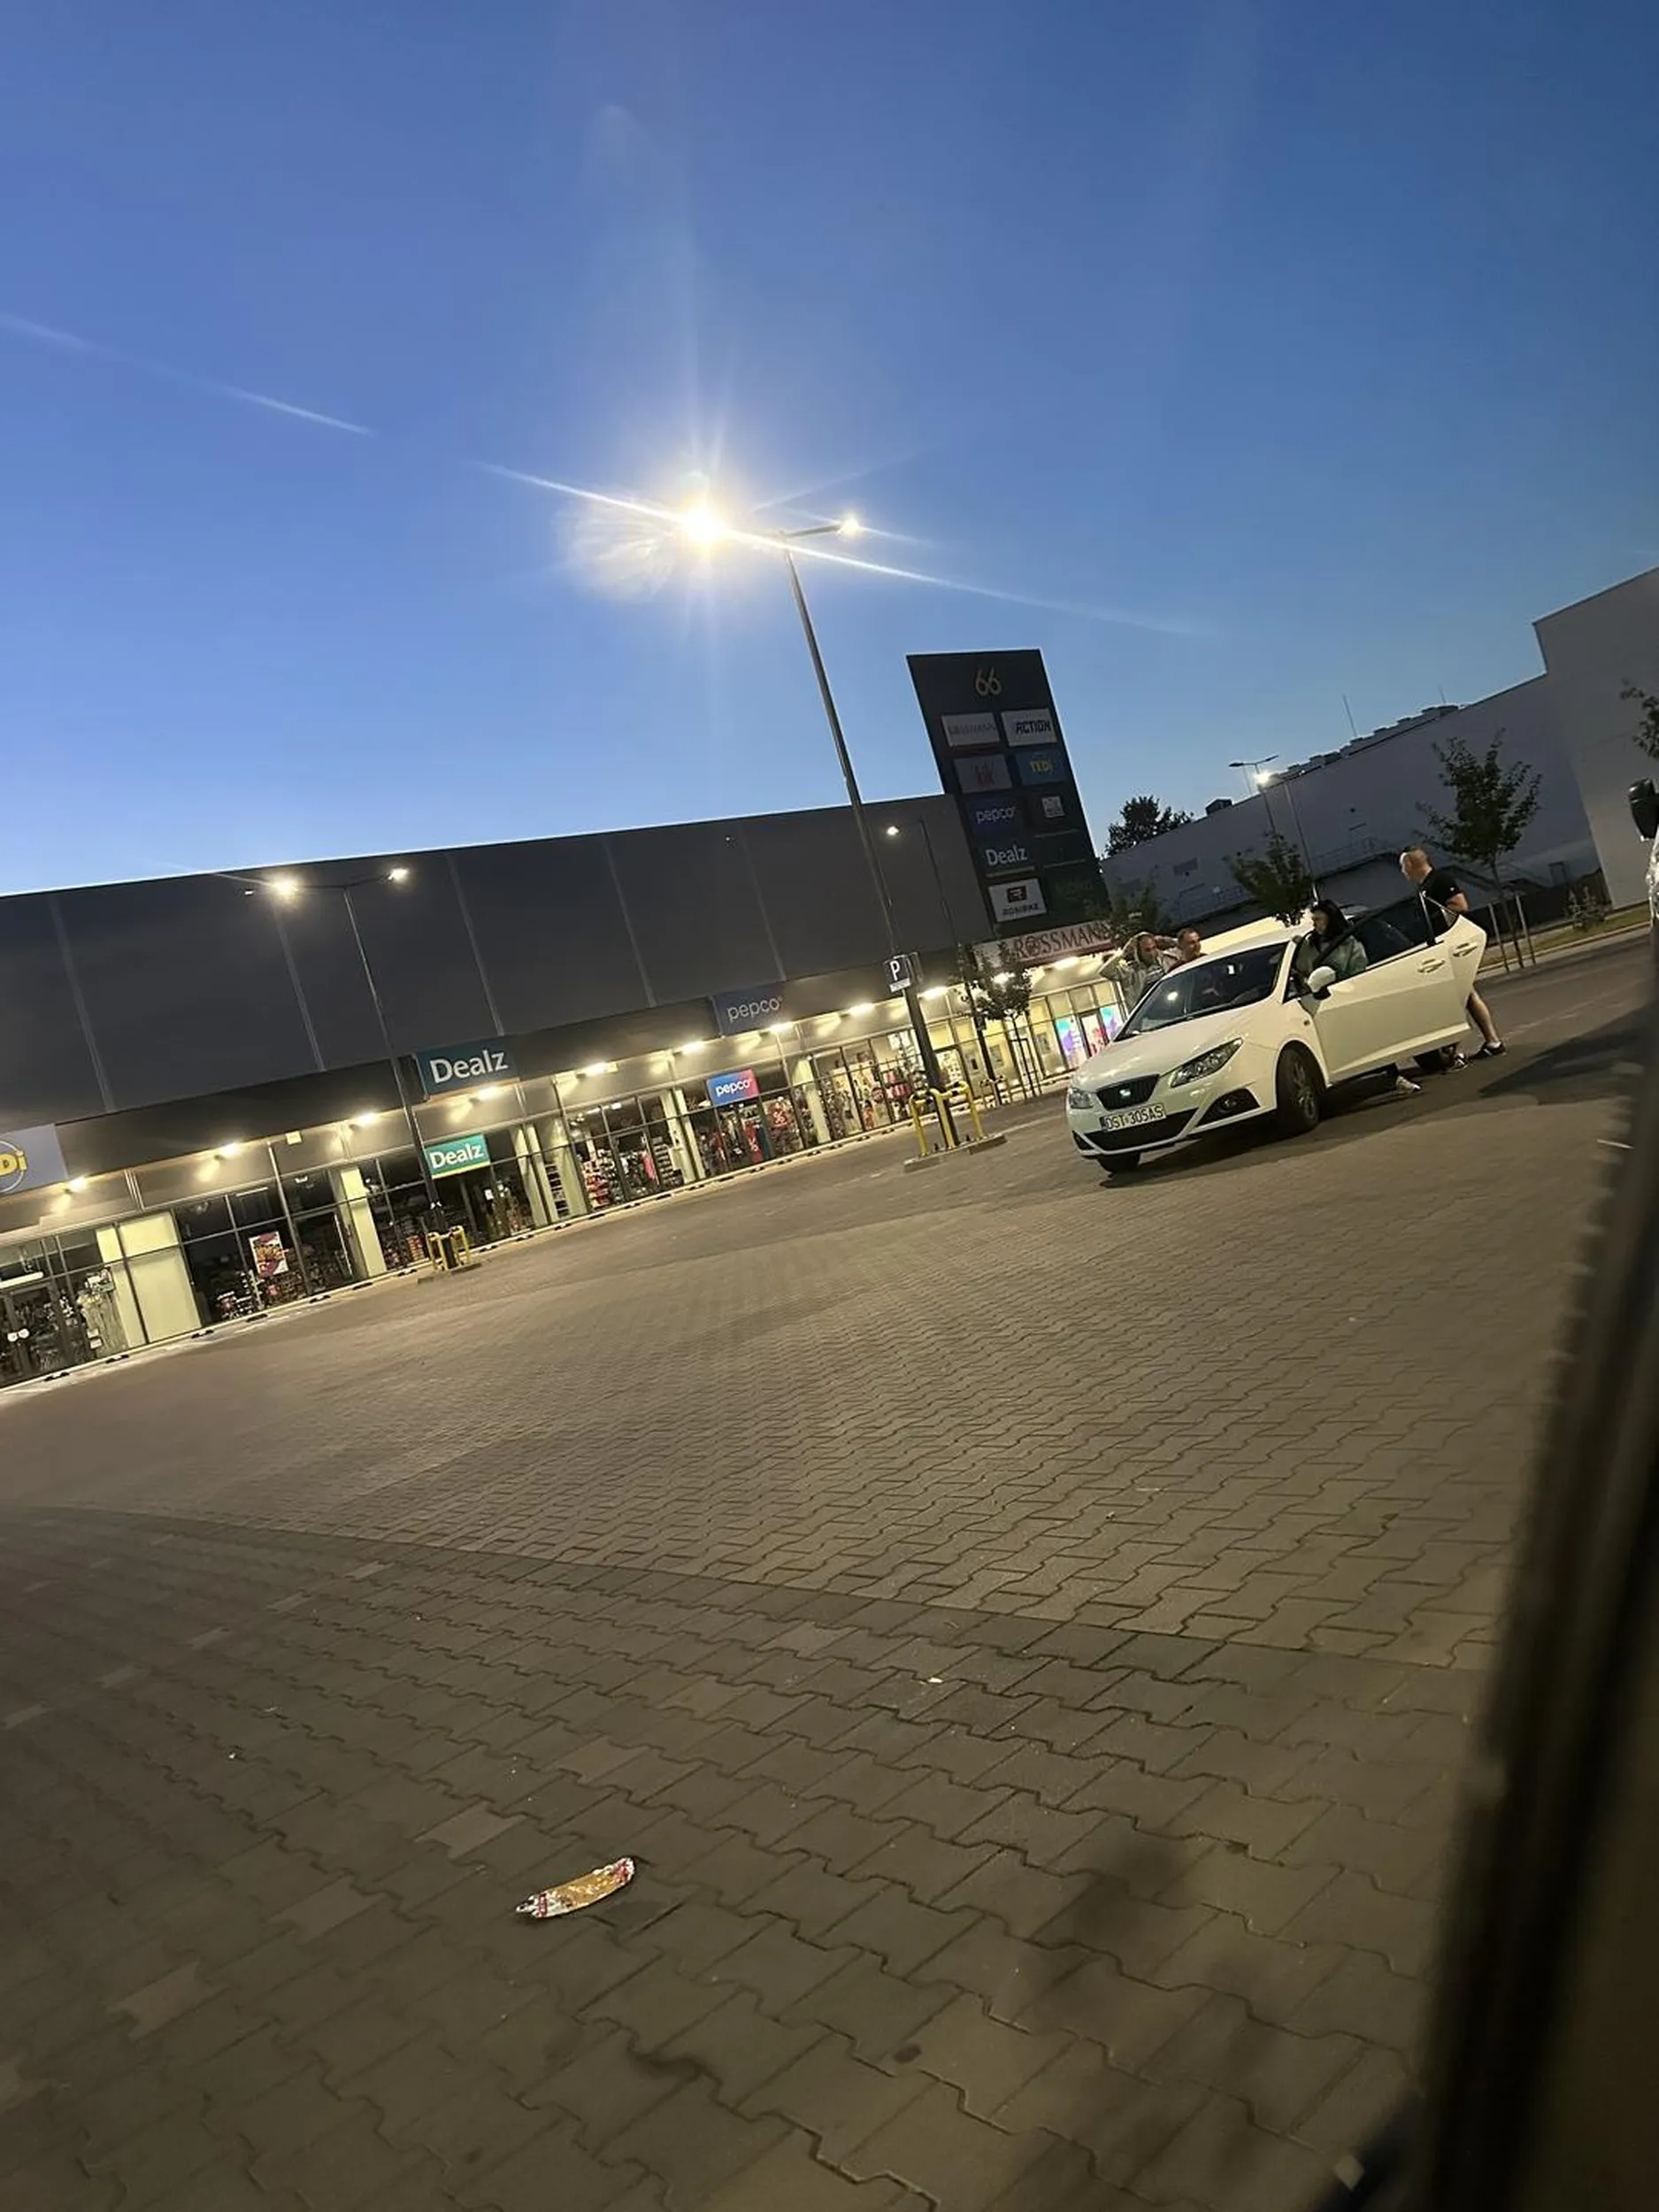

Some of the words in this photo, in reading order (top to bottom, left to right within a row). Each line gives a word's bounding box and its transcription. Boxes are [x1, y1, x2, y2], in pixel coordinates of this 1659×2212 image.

[975, 667, 1001, 696] 66
[976, 806, 1015, 825] pepco
[986, 843, 1028, 866] Dealz
[889, 960, 900, 981] P
[726, 996, 780, 1023] pepco
[429, 1049, 509, 1084] Dealz
[715, 1079, 750, 1097] pepco
[429, 1143, 485, 1170] Dealz
